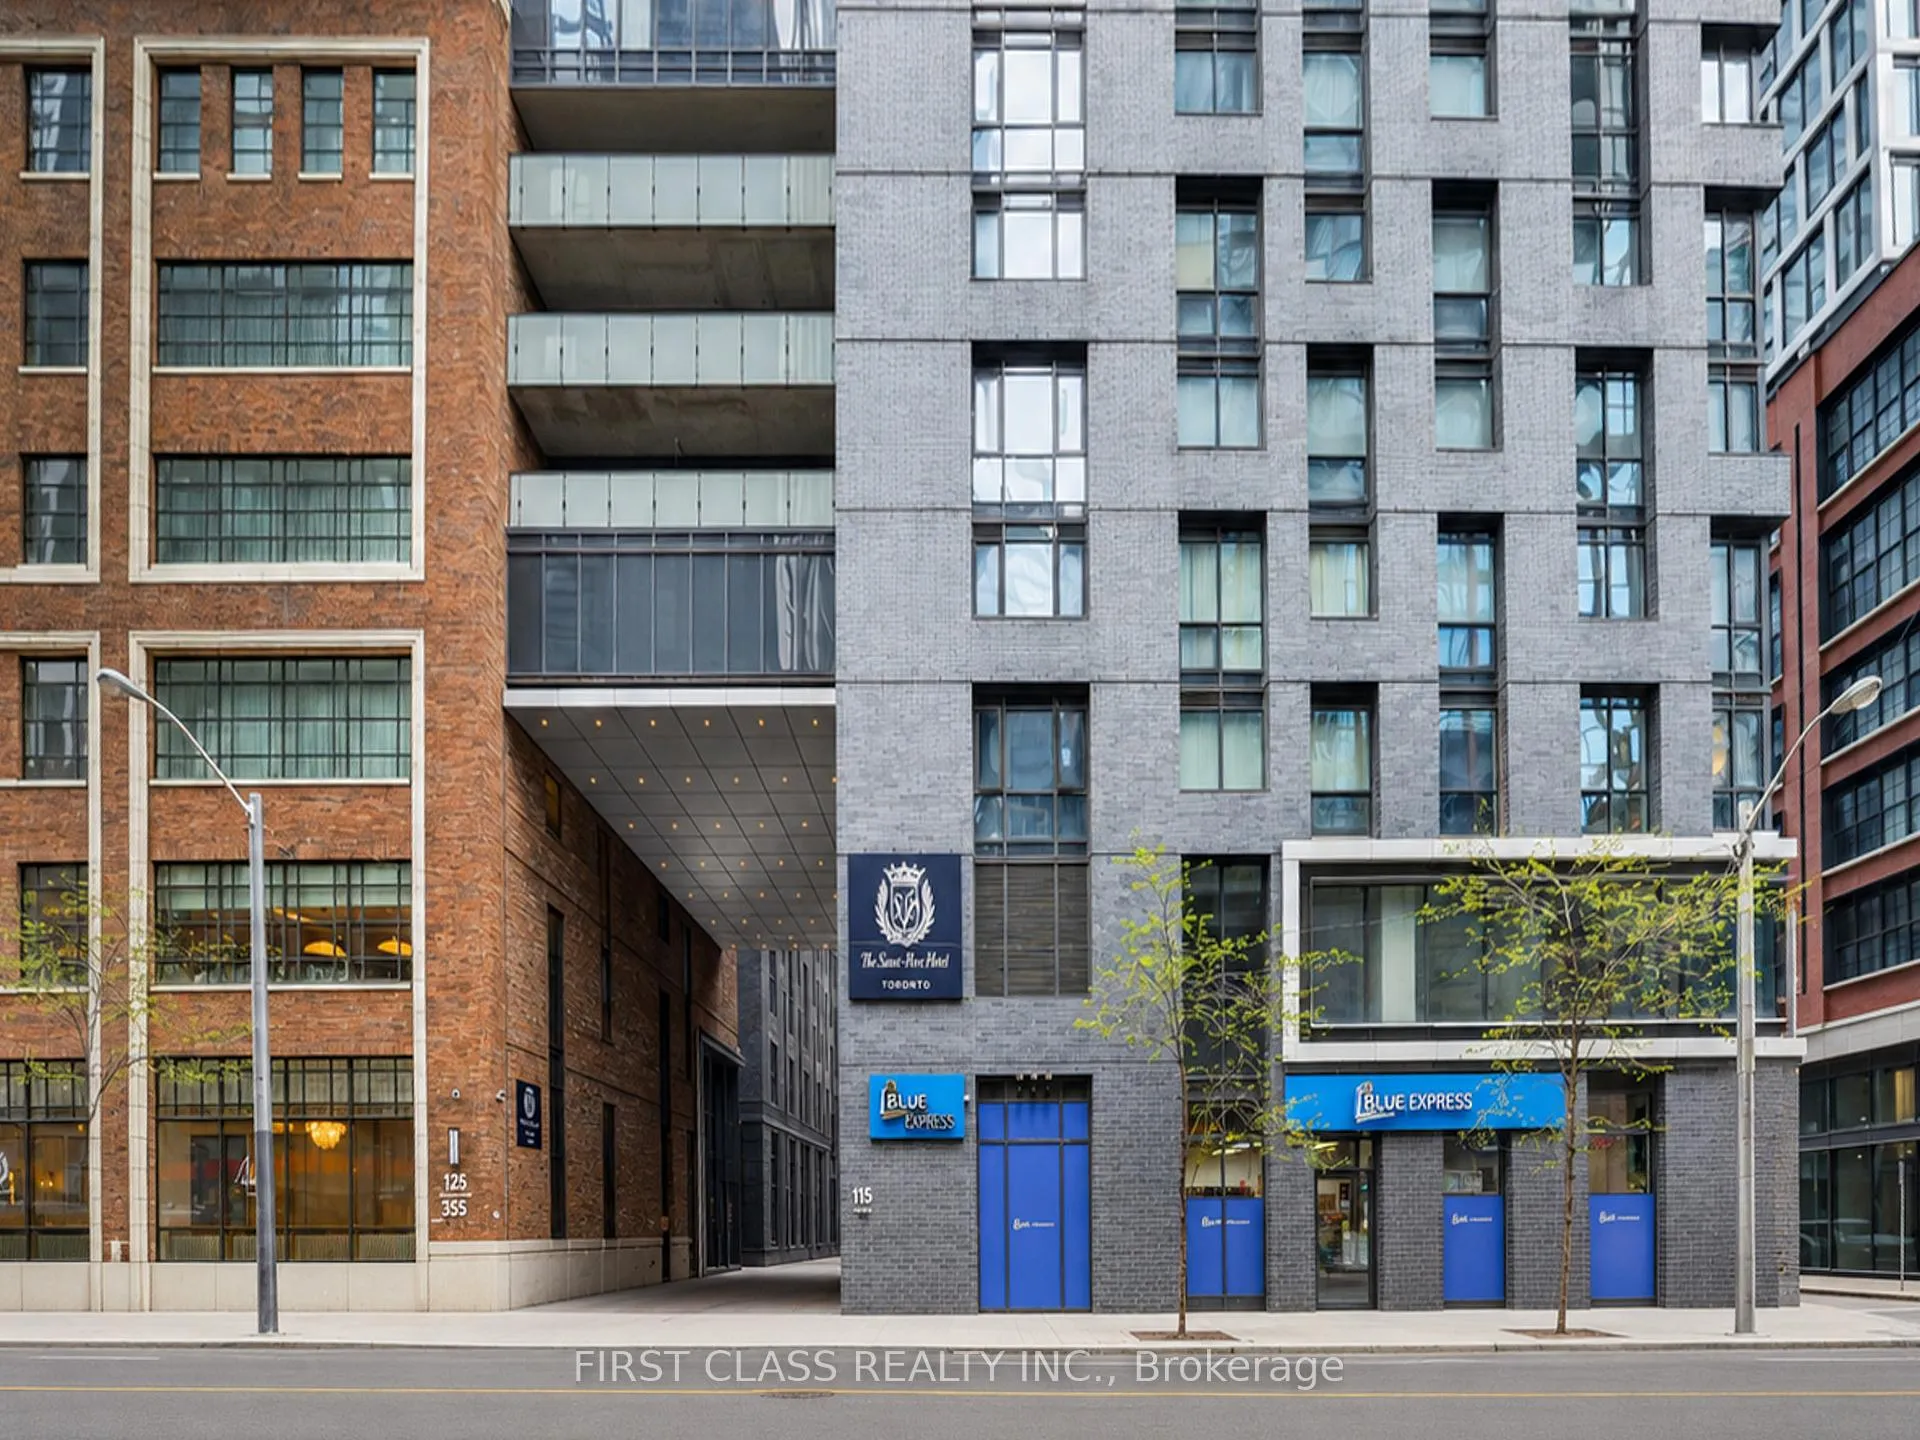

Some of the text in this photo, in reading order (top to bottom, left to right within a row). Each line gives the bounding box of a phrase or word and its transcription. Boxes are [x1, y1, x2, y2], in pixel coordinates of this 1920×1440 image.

[861, 951, 877, 968] The
[882, 980, 931, 989] TORONTO
[887, 1093, 927, 1109] BLUE
[1363, 1093, 1473, 1112] BLUE EXPRESS
[904, 1113, 955, 1129] EXPRESS
[852, 1187, 873, 1204] 115
[441, 1200, 467, 1217] 355
